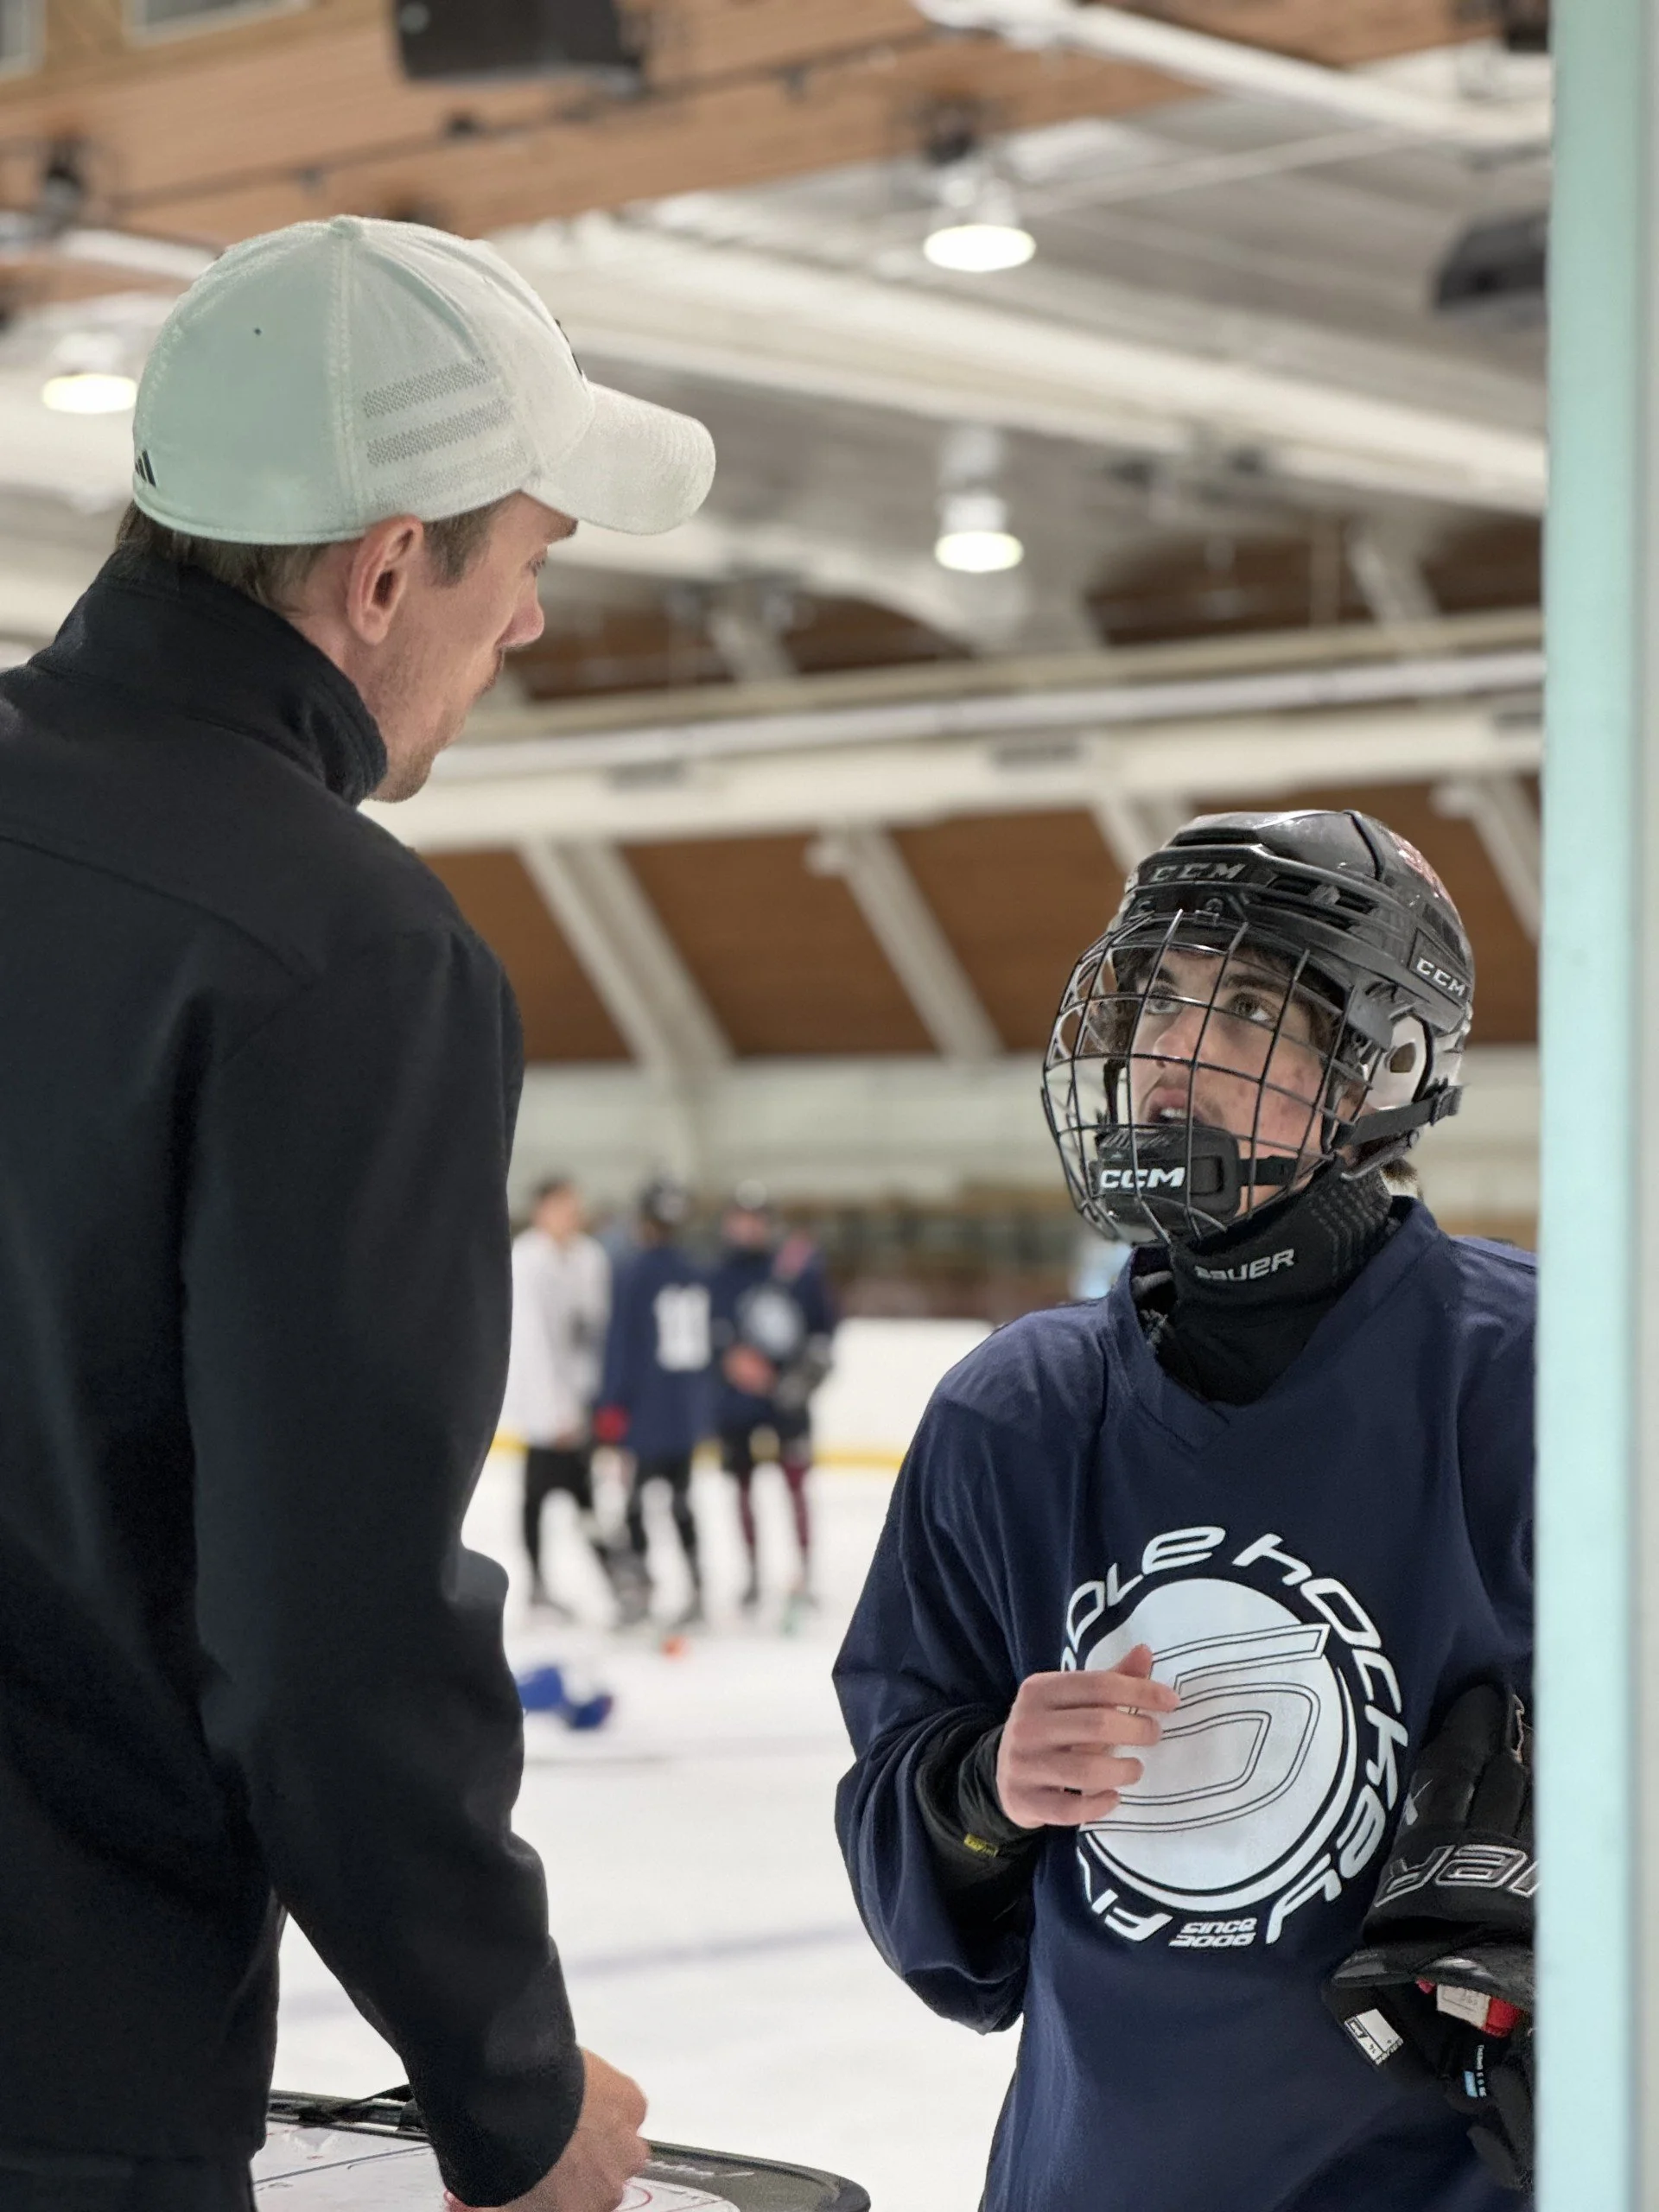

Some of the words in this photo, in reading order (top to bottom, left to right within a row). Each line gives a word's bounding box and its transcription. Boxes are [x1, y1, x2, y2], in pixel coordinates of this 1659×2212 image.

[1149, 862, 1246, 883] CCM
[1416, 957, 1466, 996] CCM
[1101, 1166, 1185, 1188] CCM
